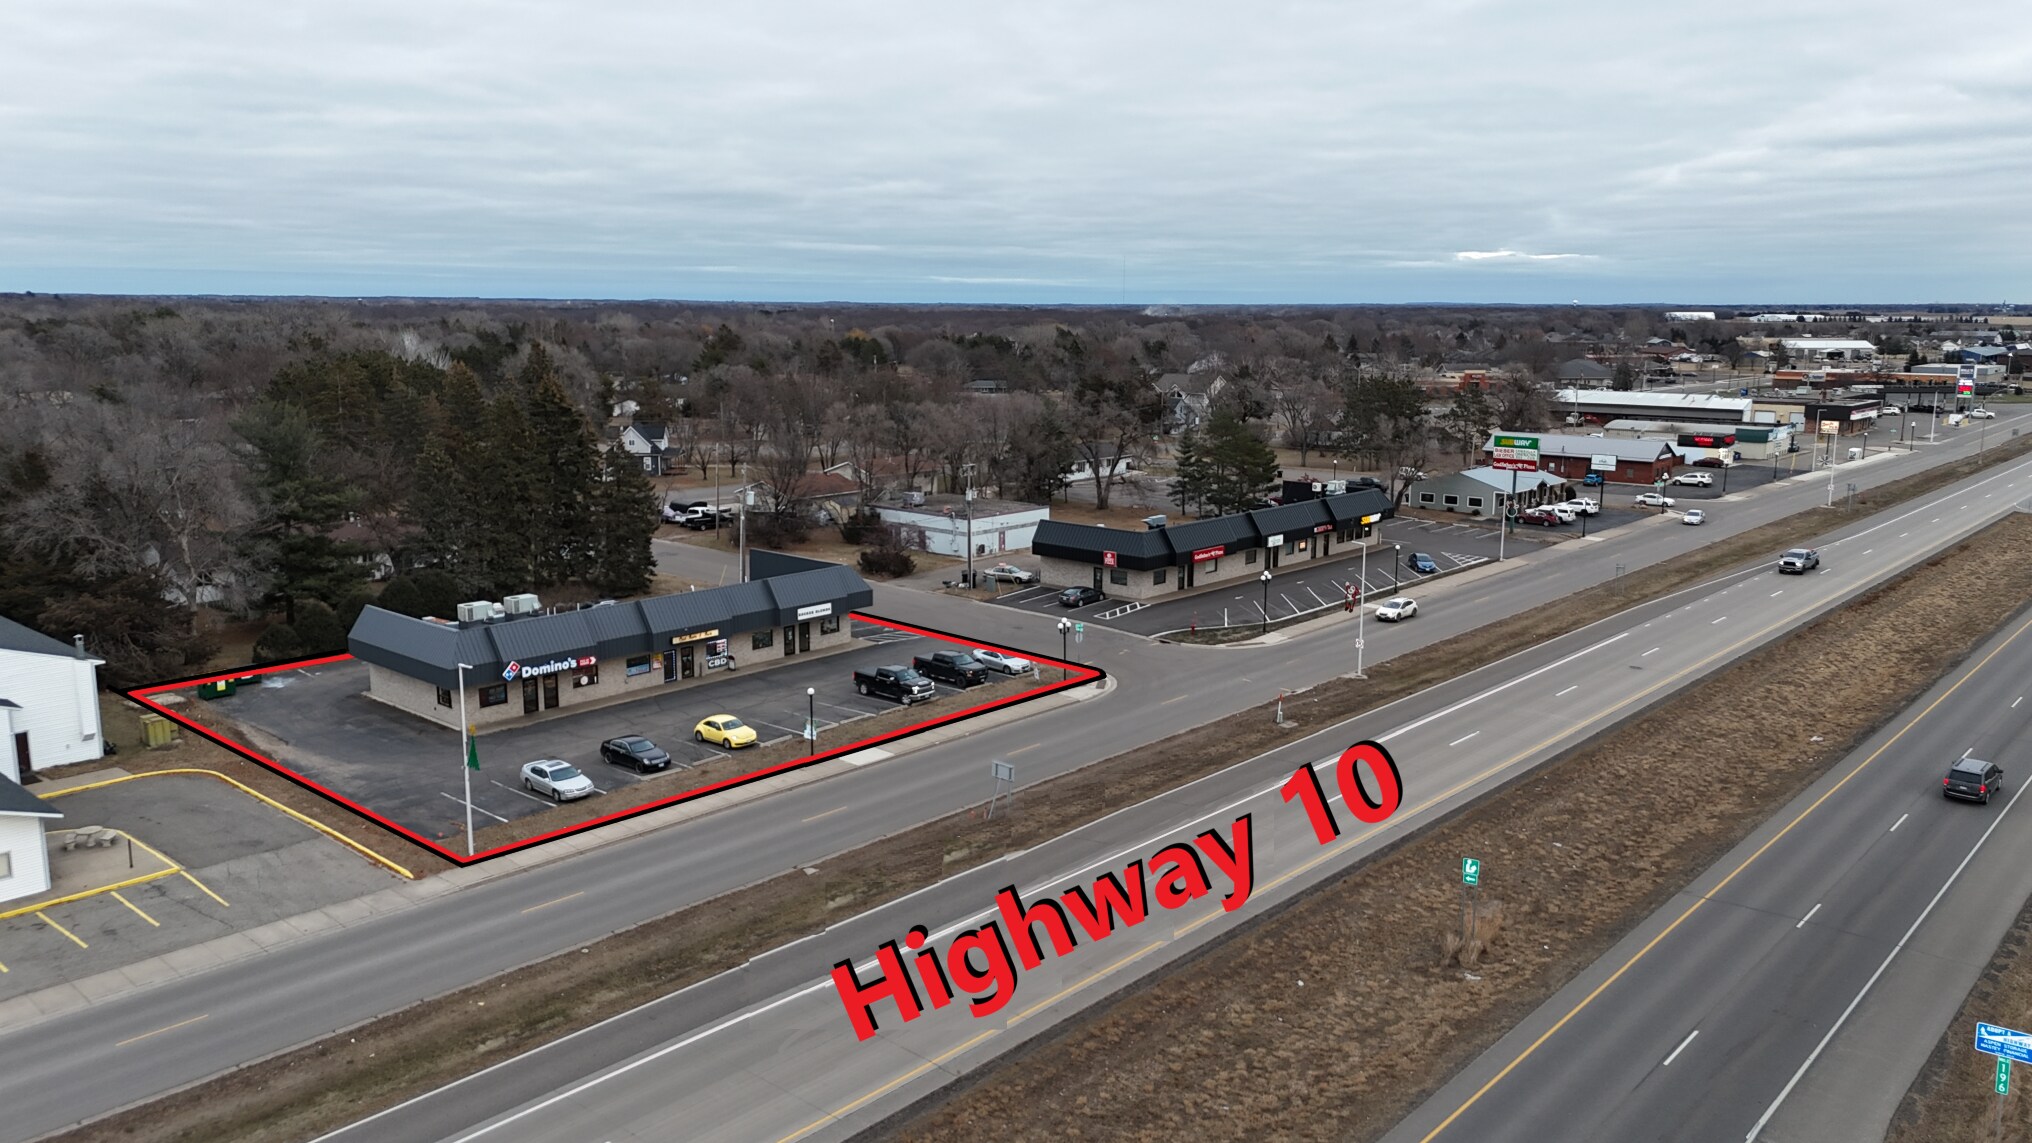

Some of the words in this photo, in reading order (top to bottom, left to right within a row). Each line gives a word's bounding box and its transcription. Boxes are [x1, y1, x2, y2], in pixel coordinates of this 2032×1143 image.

[1500, 438, 1532, 447] SUBWAY
[521, 657, 578, 678] Domino's
[708, 657, 727, 668] CBD
[1987, 1026, 2005, 1035] ADOPT
[1983, 1039, 2002, 1047] ASPEN
[2003, 1044, 2028, 1054] STORAGE
[2003, 1037, 2031, 1048] HIGHWAY
[2003, 1049, 2029, 1059] FINANCIAL
[1998, 1063, 2007, 1092] 196
